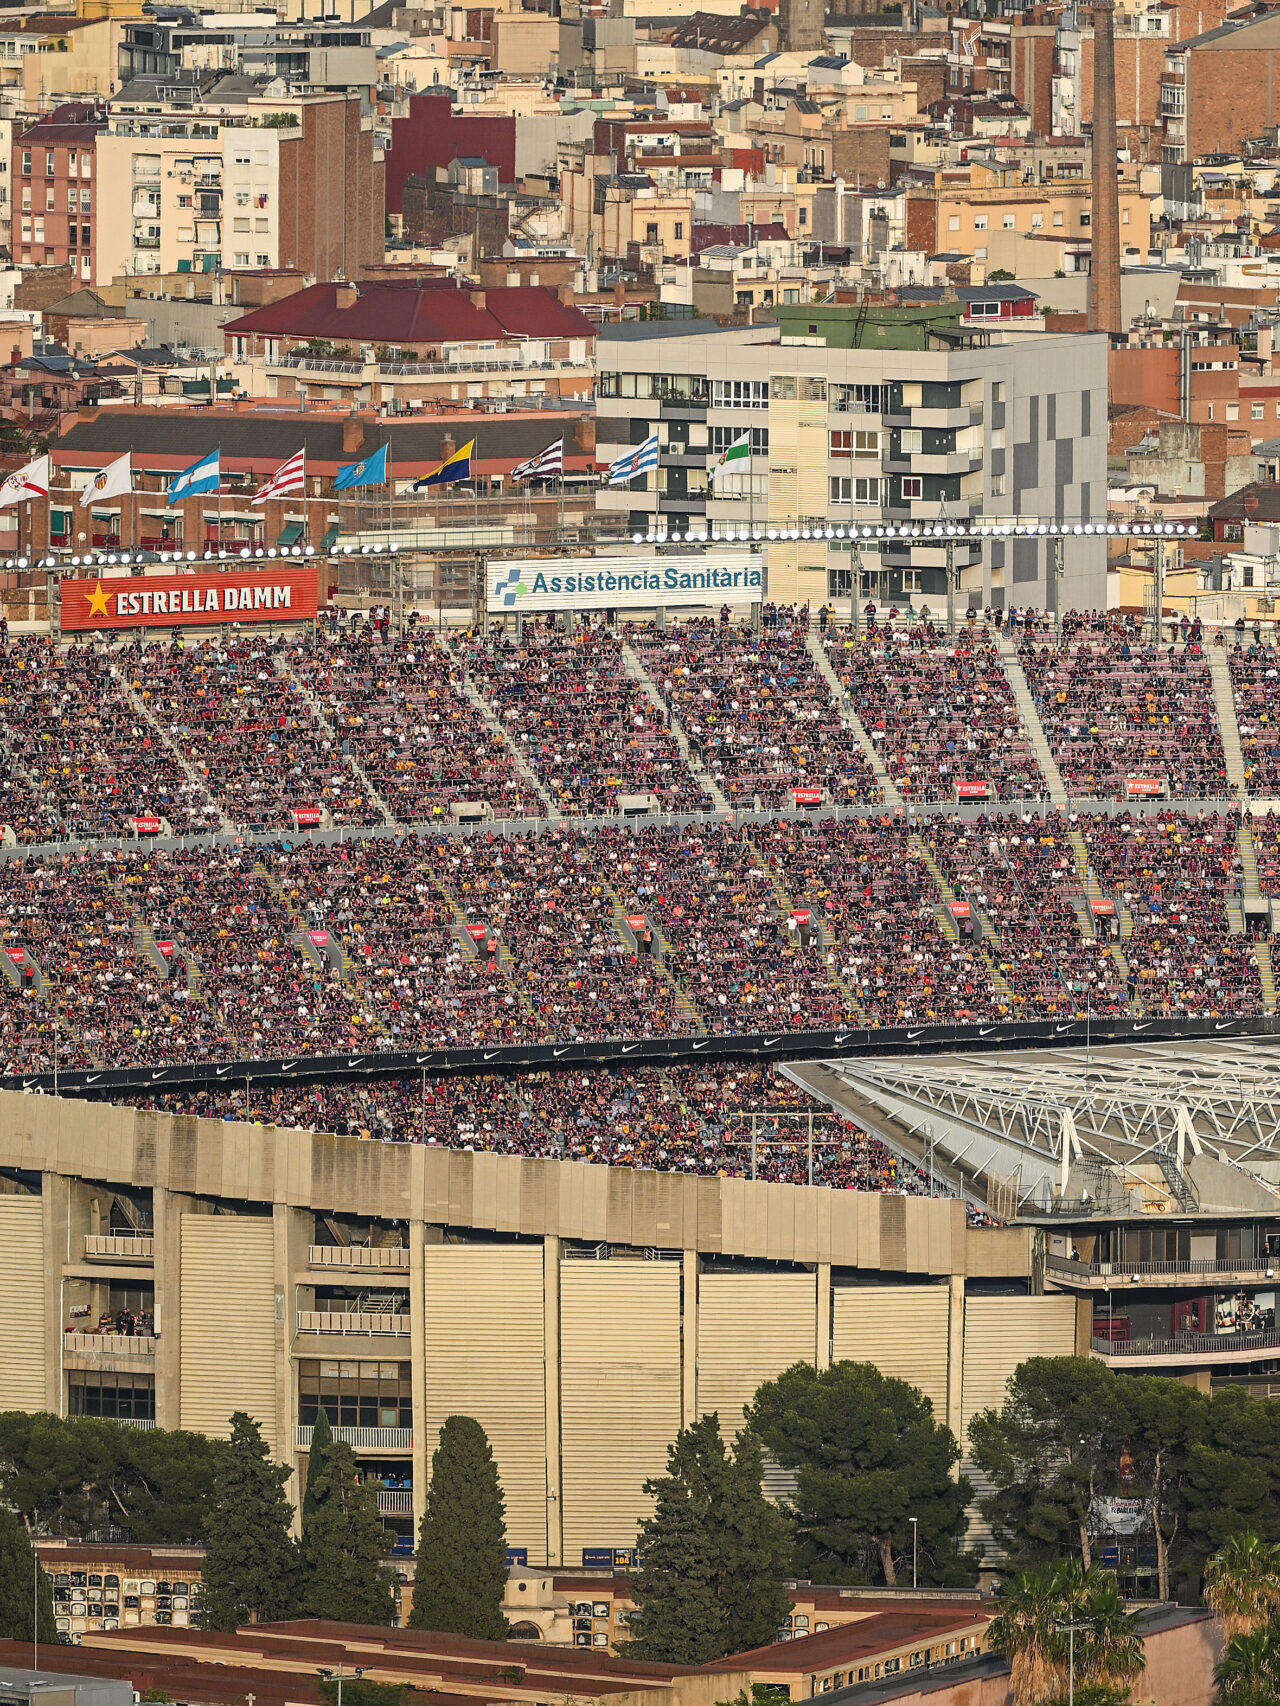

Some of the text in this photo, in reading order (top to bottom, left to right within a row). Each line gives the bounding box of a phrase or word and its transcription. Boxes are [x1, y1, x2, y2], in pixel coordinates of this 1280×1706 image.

[532, 568, 762, 594] Assistència Sanitària
[116, 586, 291, 615] ESTRELLA DAMM
